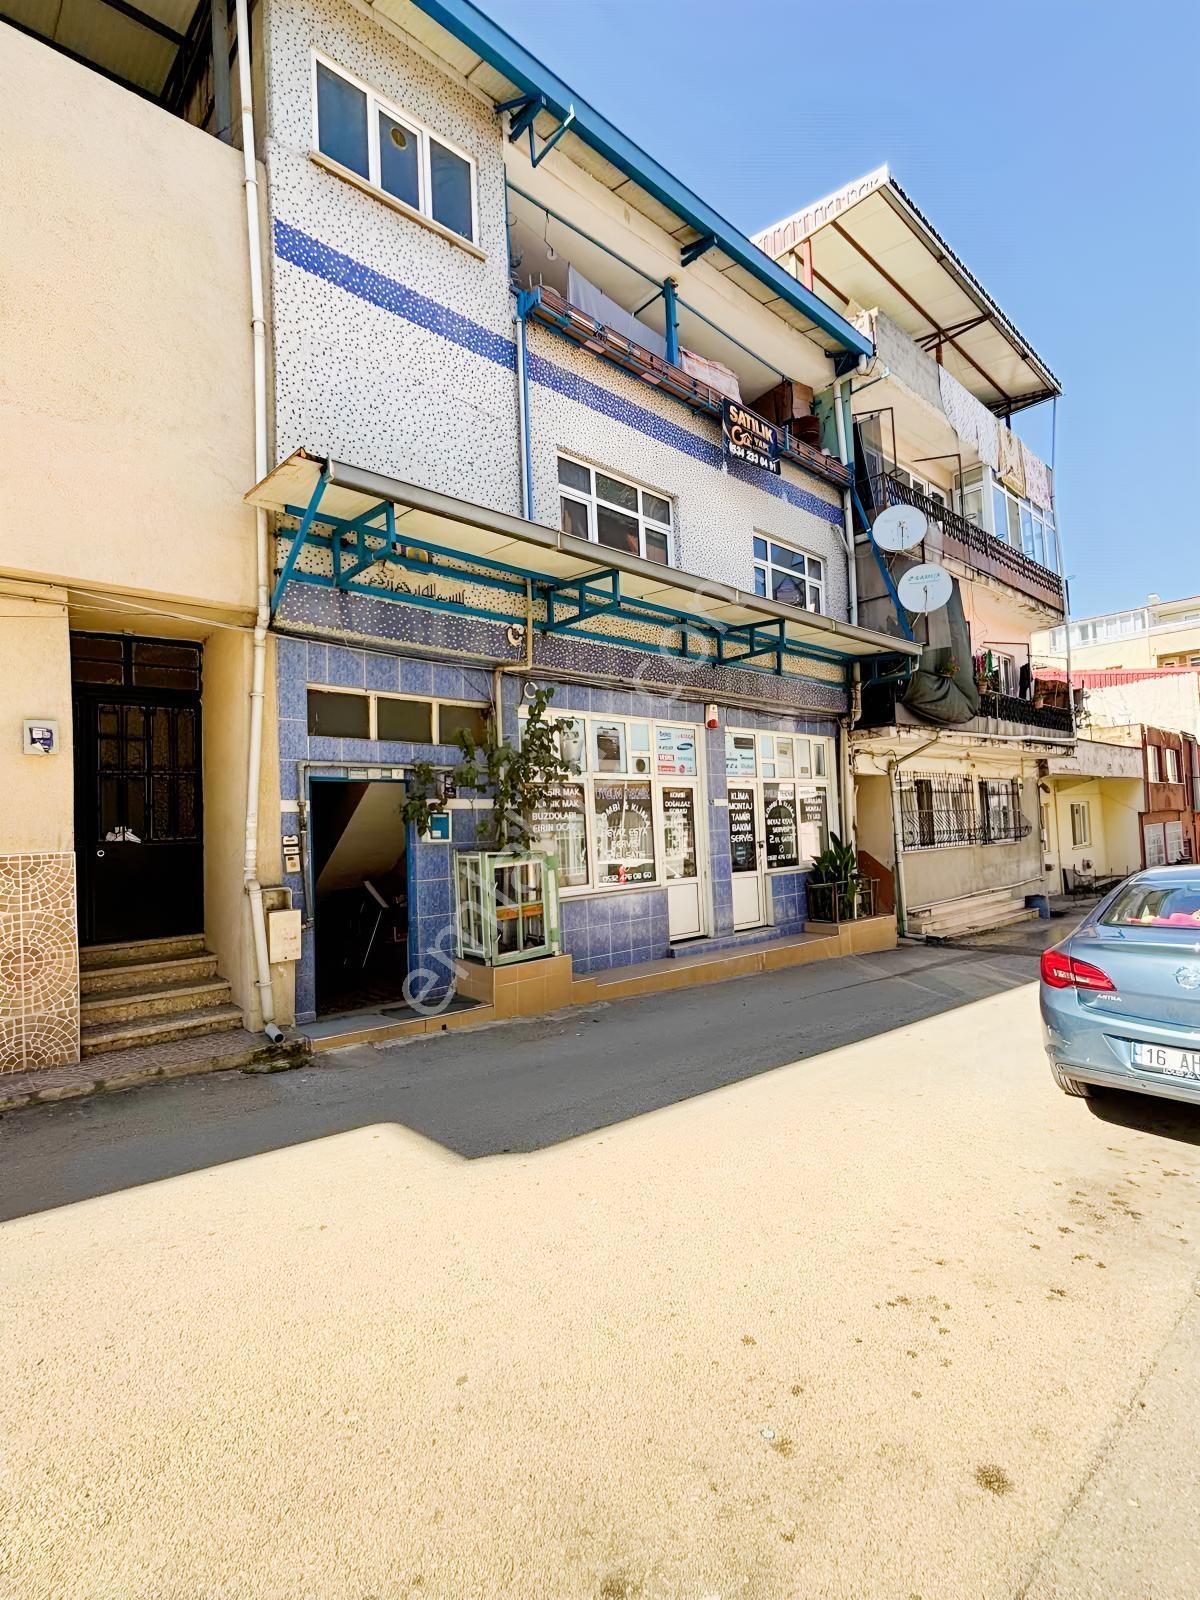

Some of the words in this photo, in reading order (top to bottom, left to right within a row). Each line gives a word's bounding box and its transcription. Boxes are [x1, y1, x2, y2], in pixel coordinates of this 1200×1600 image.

[730, 405, 773, 443] SATILIK
[730, 791, 750, 800] KLİMA
[728, 802, 753, 810] MONTAJ
[731, 811, 751, 821] TAMİR
[731, 822, 752, 832] BAKIM
[730, 832, 754, 843] SERVİS
[1147, 1049, 1166, 1066] 16
